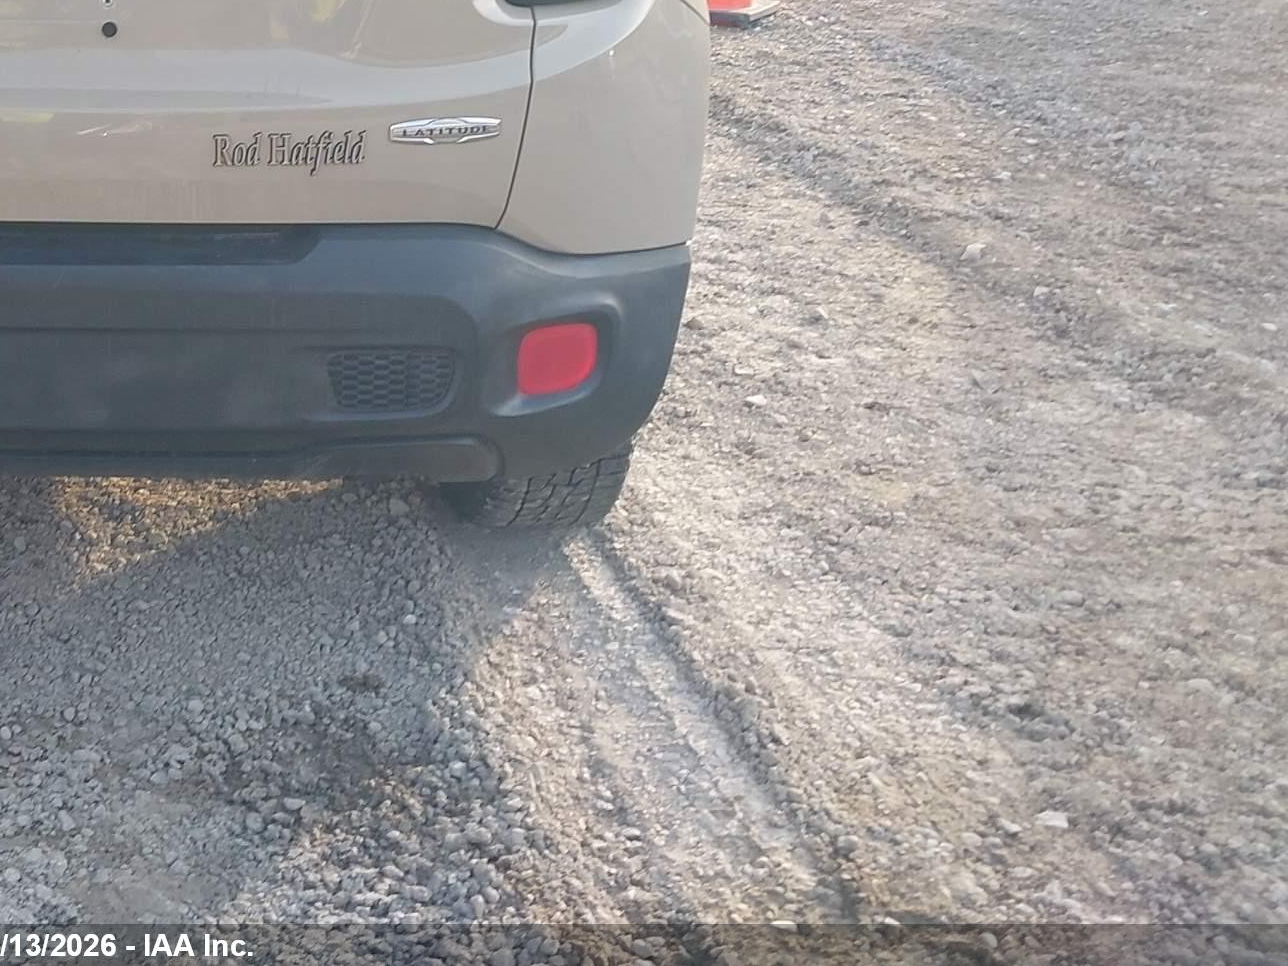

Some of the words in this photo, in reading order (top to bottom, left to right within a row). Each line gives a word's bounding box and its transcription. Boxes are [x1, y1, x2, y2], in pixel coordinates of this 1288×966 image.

[402, 125, 489, 137] LATITUDE
[212, 132, 262, 167] Rod
[266, 131, 366, 175] Hatfield
